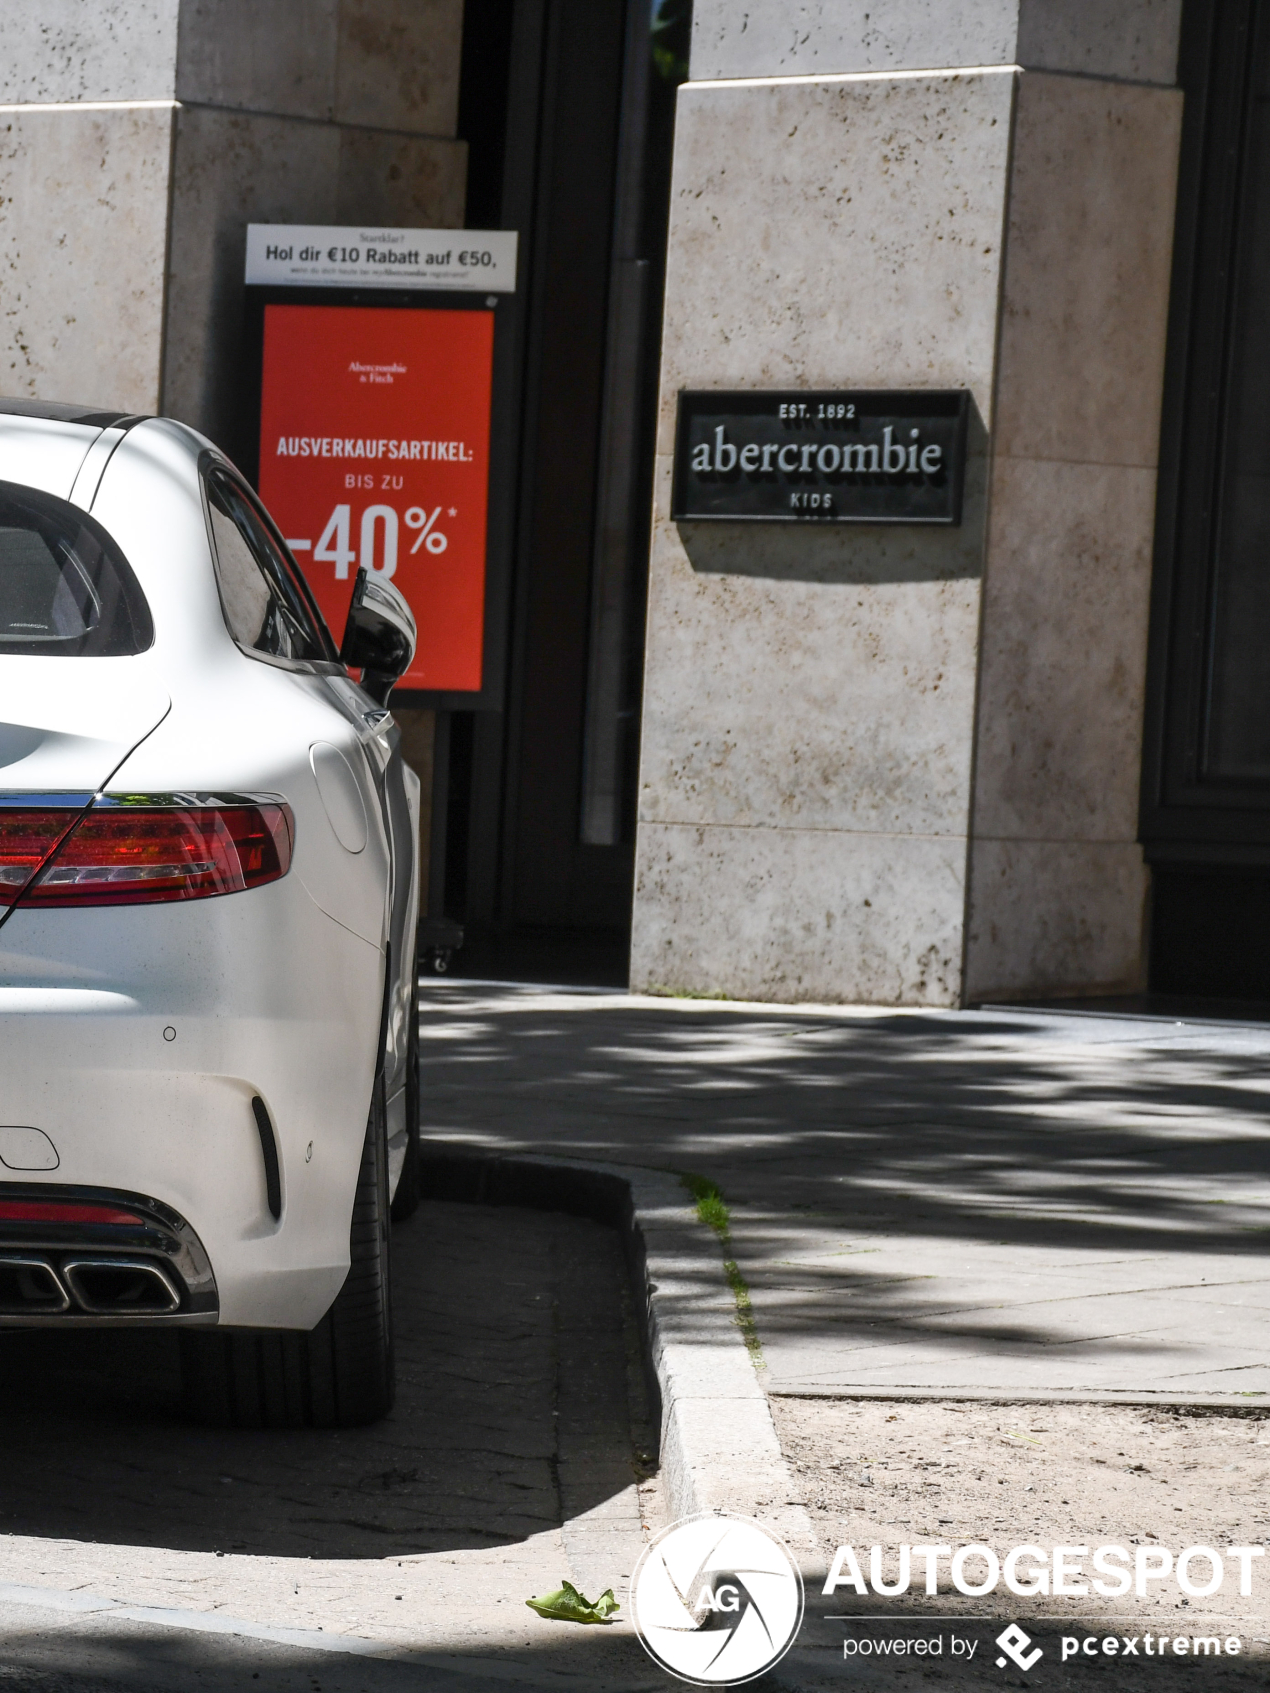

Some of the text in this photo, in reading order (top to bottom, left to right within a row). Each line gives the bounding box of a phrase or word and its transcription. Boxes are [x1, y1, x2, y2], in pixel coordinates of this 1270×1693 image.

[265, 245, 497, 268] Hol dir €10 Rabatt auf €50,
[348, 361, 407, 374] Abercrombie
[369, 372, 394, 384] Fitch
[779, 403, 856, 419] EST. 1892
[277, 436, 473, 462] AUSVERKAUFSARTIKEL:
[691, 424, 942, 474] abercrombie
[344, 474, 404, 490] BIS ZU
[790, 493, 832, 508] KIDS
